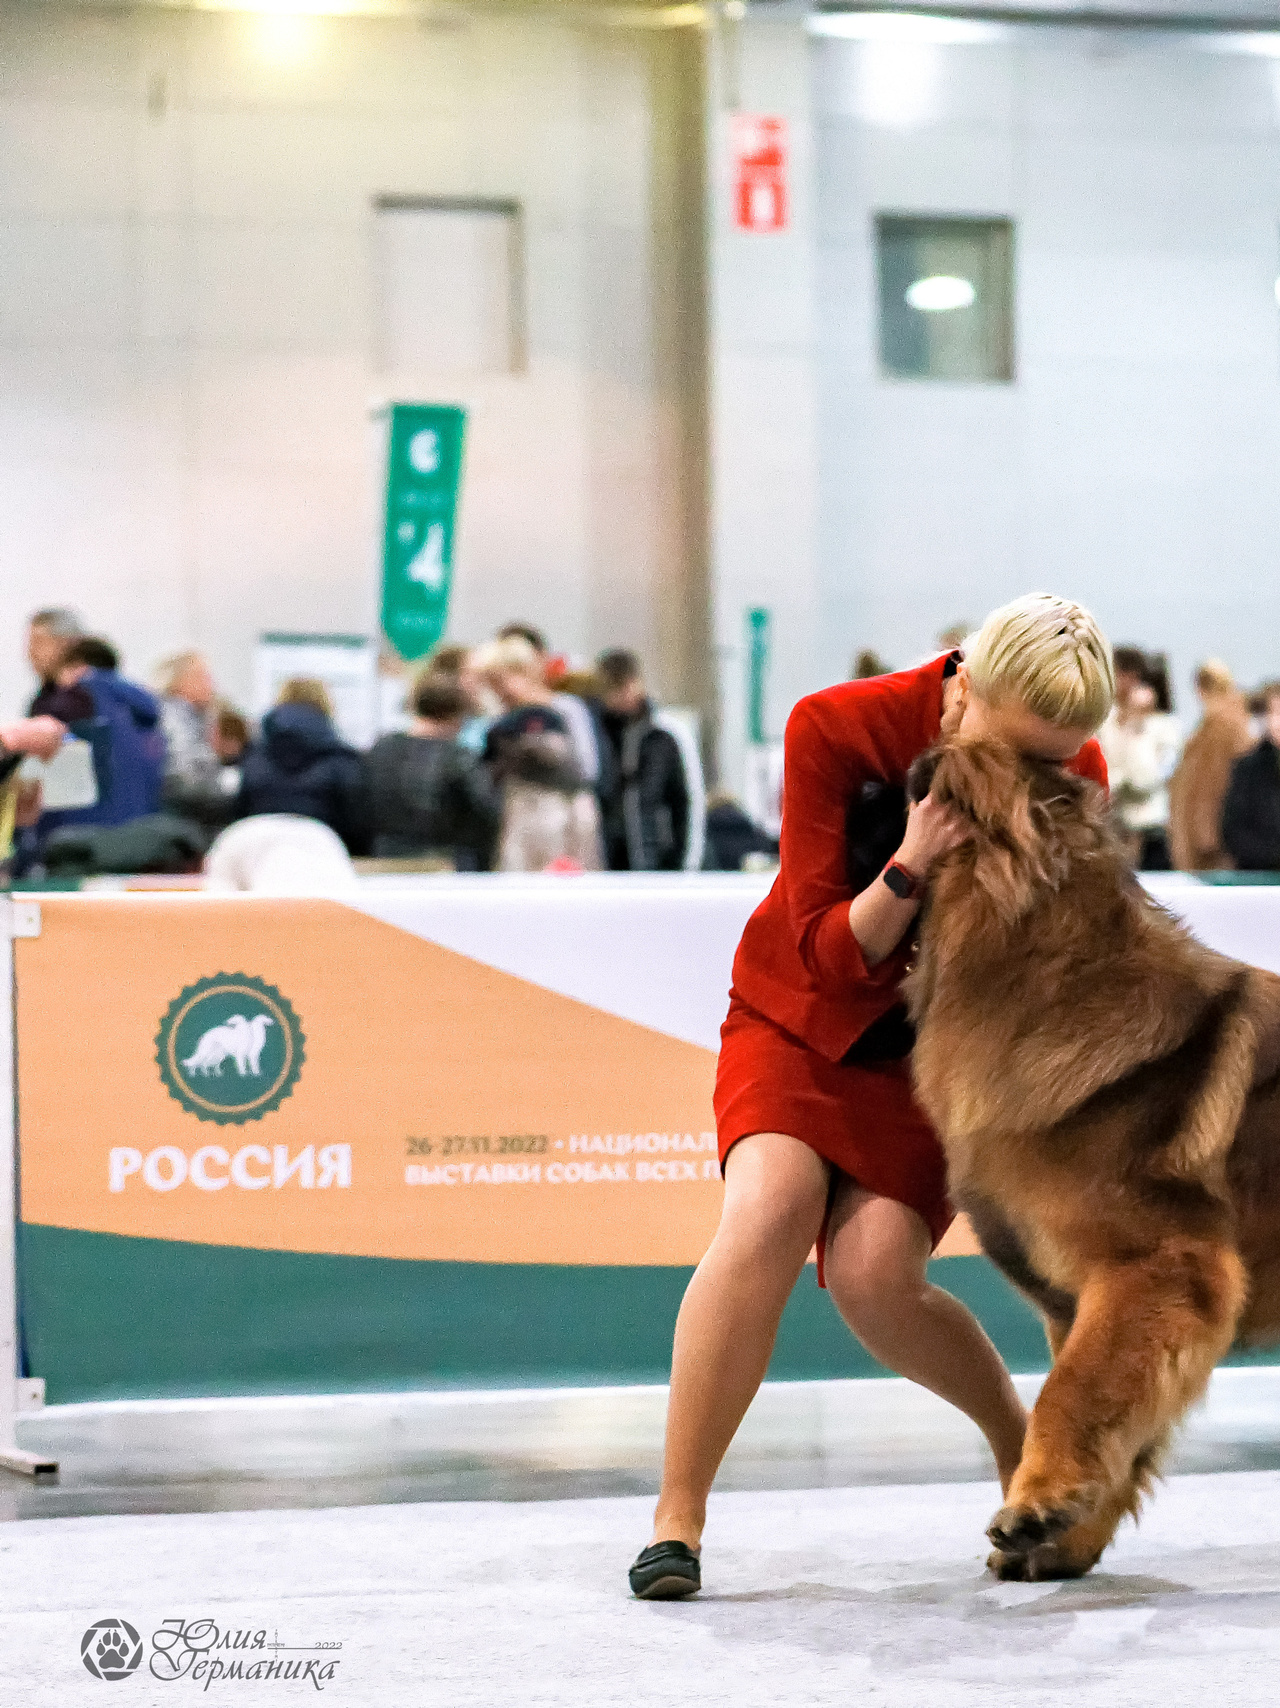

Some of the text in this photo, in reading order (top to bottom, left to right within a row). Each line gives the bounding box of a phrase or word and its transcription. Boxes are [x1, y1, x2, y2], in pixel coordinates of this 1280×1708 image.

[108, 1143, 353, 1193] РОССИЯ
[405, 1162, 542, 1185] ВЫСТАВКИ
[546, 1161, 630, 1184] СОБАК
[635, 1160, 697, 1182] ВСЕХ
